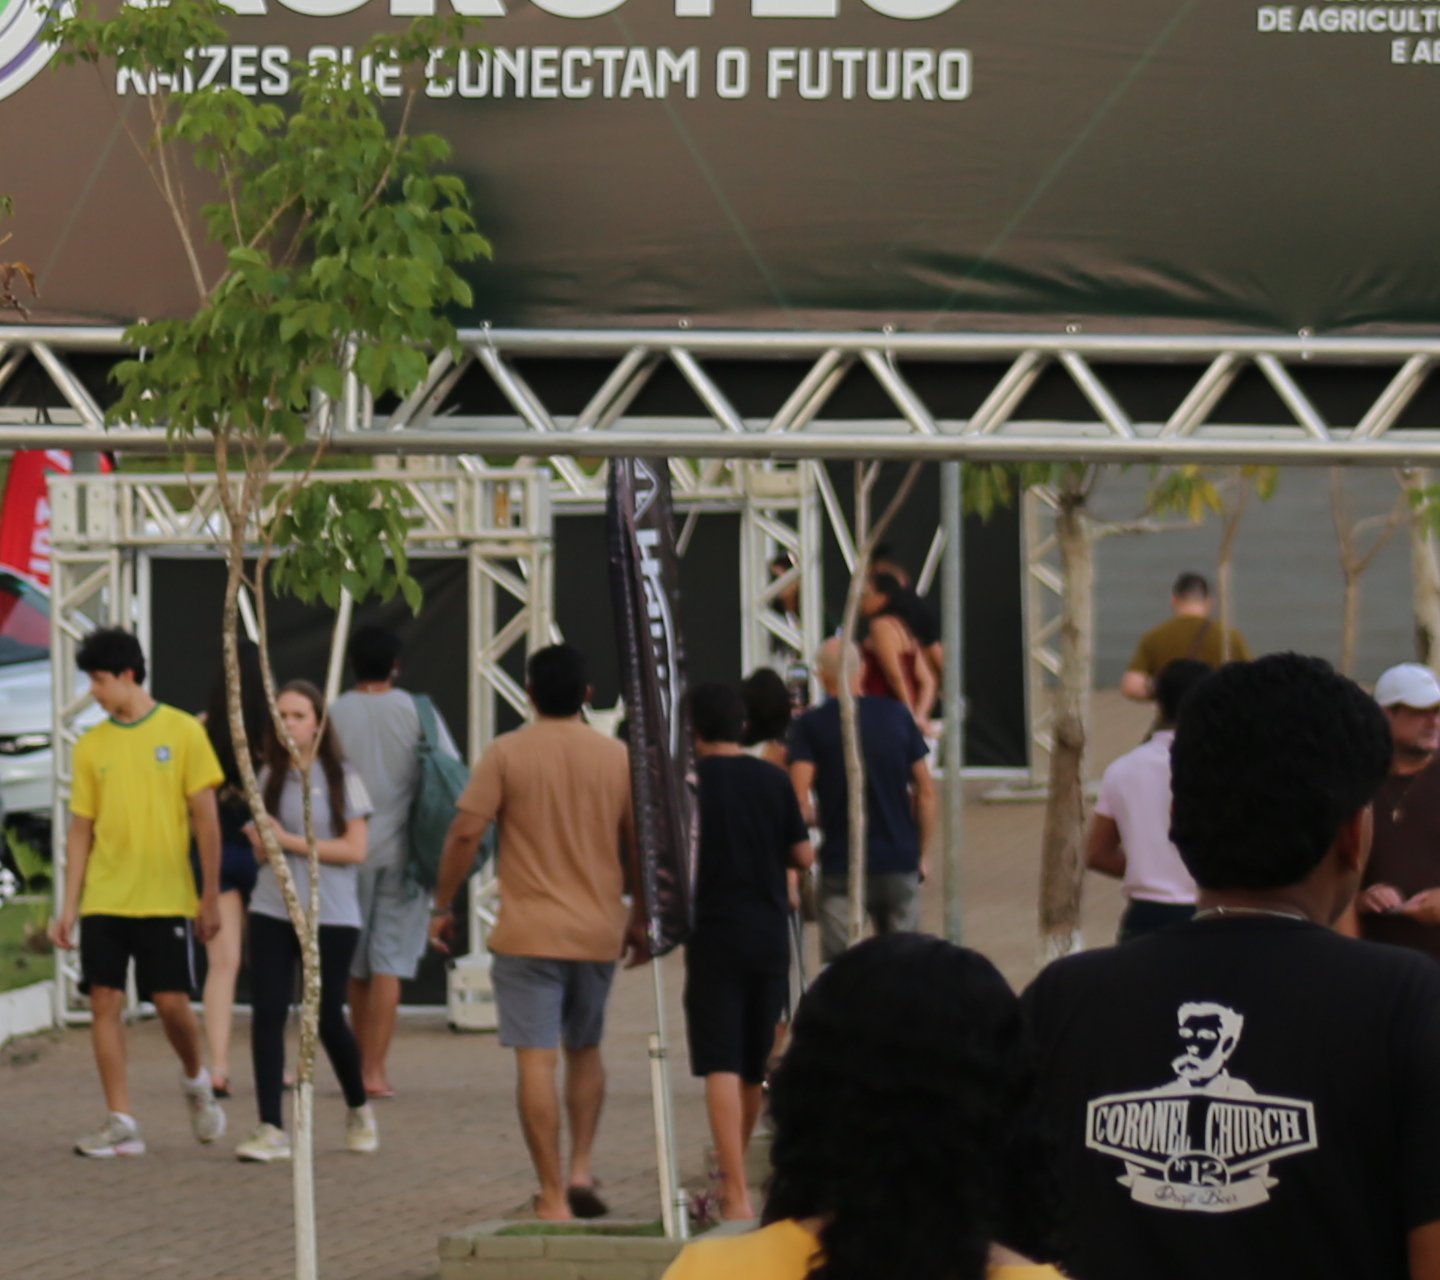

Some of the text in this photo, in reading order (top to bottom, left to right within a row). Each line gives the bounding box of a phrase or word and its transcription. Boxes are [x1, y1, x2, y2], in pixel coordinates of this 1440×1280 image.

[1256, 7, 1292, 32] DE
[1391, 40, 1408, 64] E
[715, 46, 750, 100] O
[766, 47, 974, 102] FUTURO
[1094, 1099, 1303, 1160] CORONEL CHURCH
